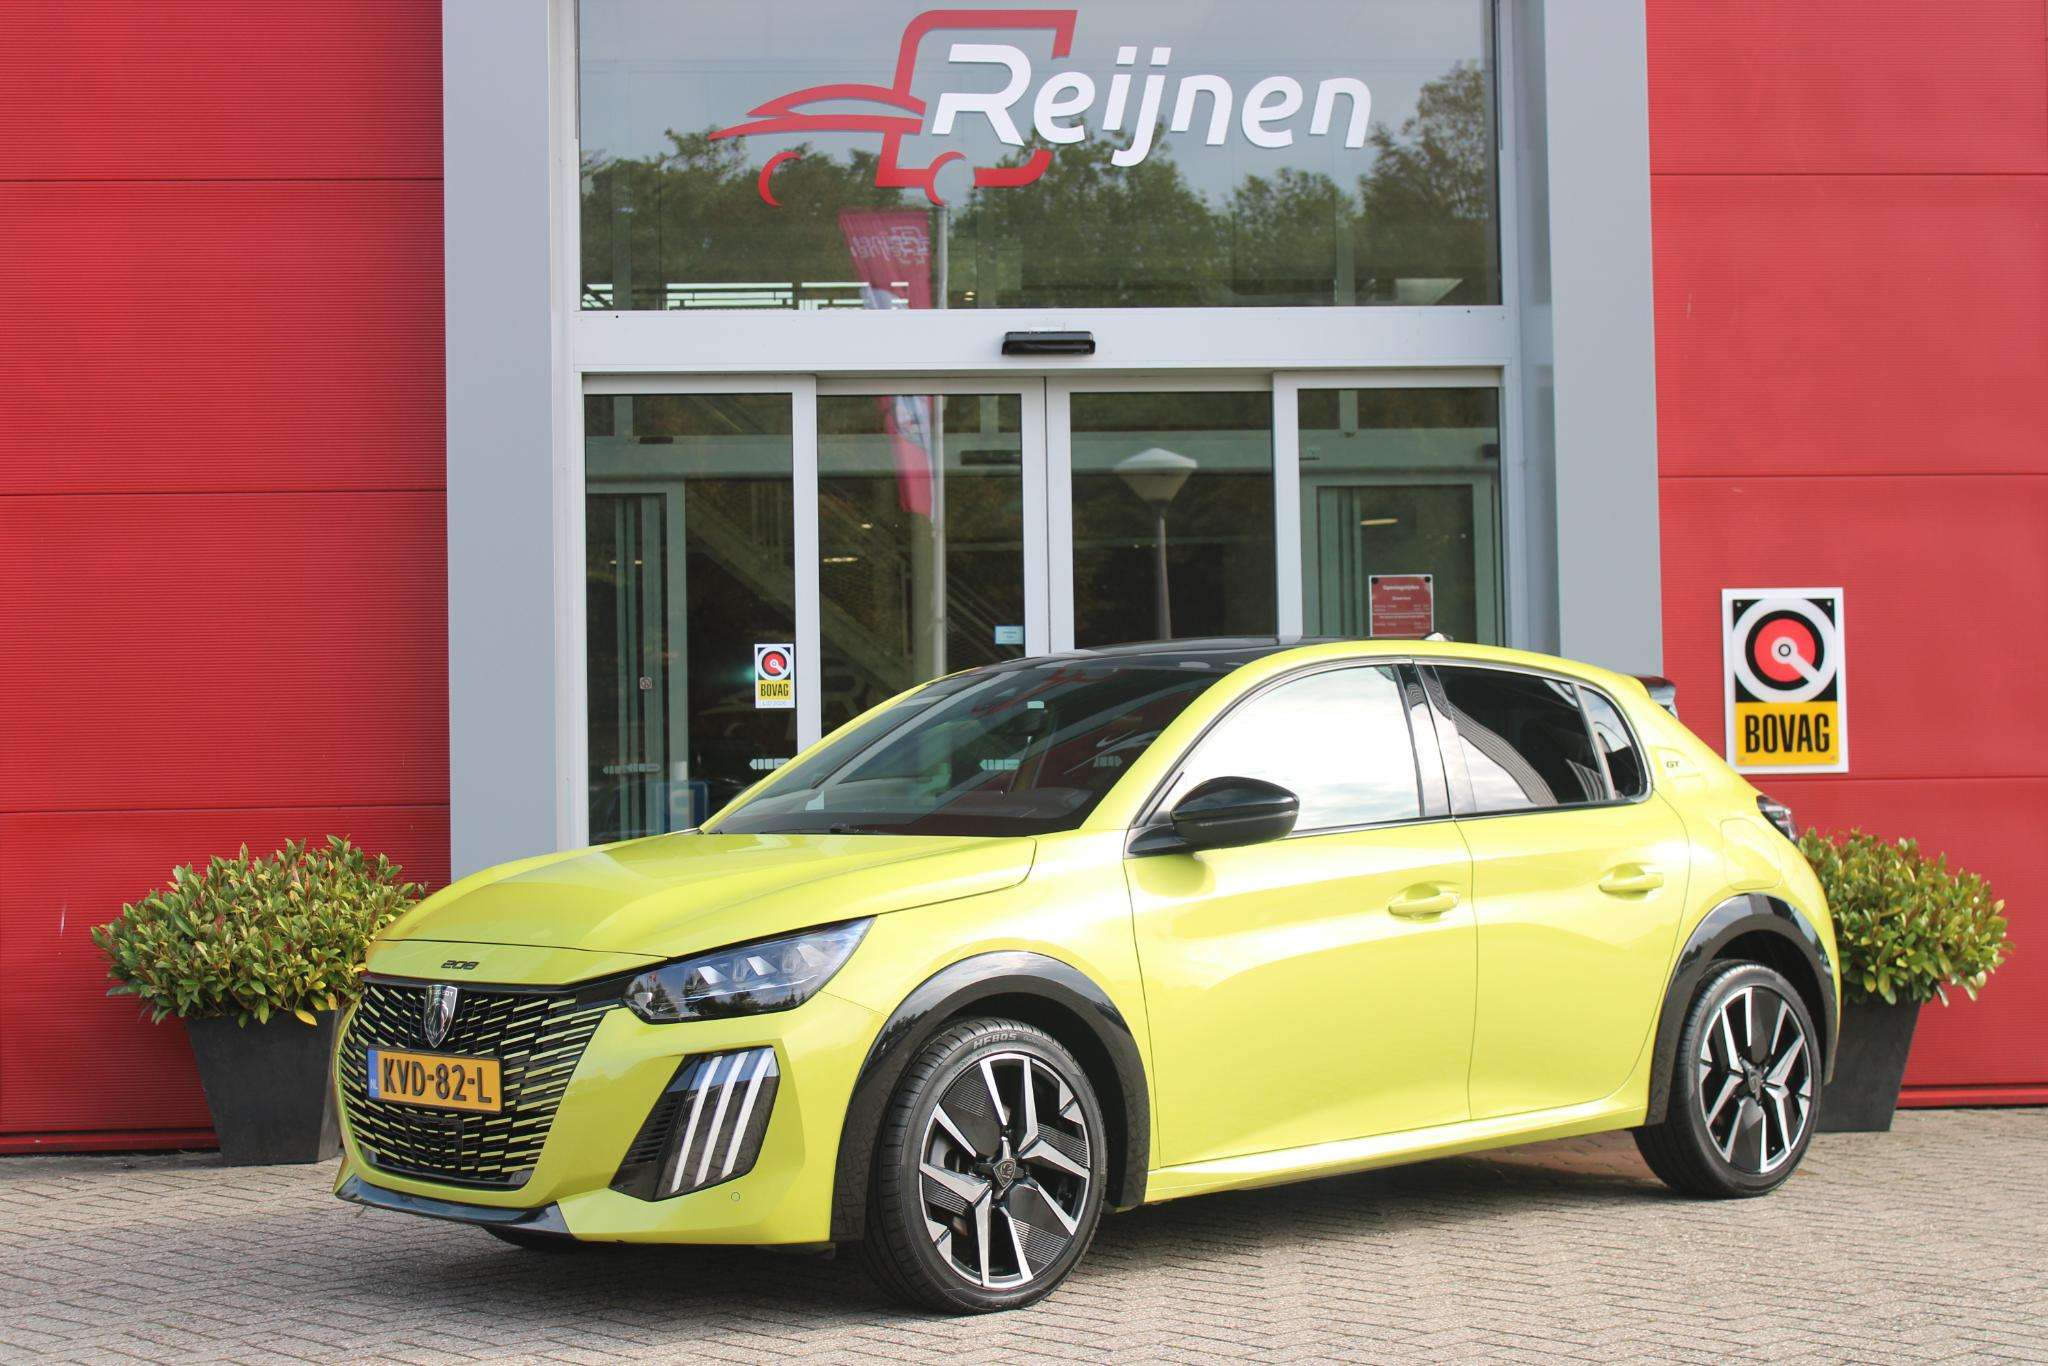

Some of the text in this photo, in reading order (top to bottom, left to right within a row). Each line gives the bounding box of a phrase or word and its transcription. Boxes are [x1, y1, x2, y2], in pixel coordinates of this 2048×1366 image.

[932, 44, 1372, 167] Reijnen
[760, 683, 789, 697] BOVAG
[1744, 713, 1830, 754] BOVAG
[1666, 760, 1680, 769] GT
[441, 960, 480, 970] 208
[383, 1057, 492, 1104] KVD-82-L
